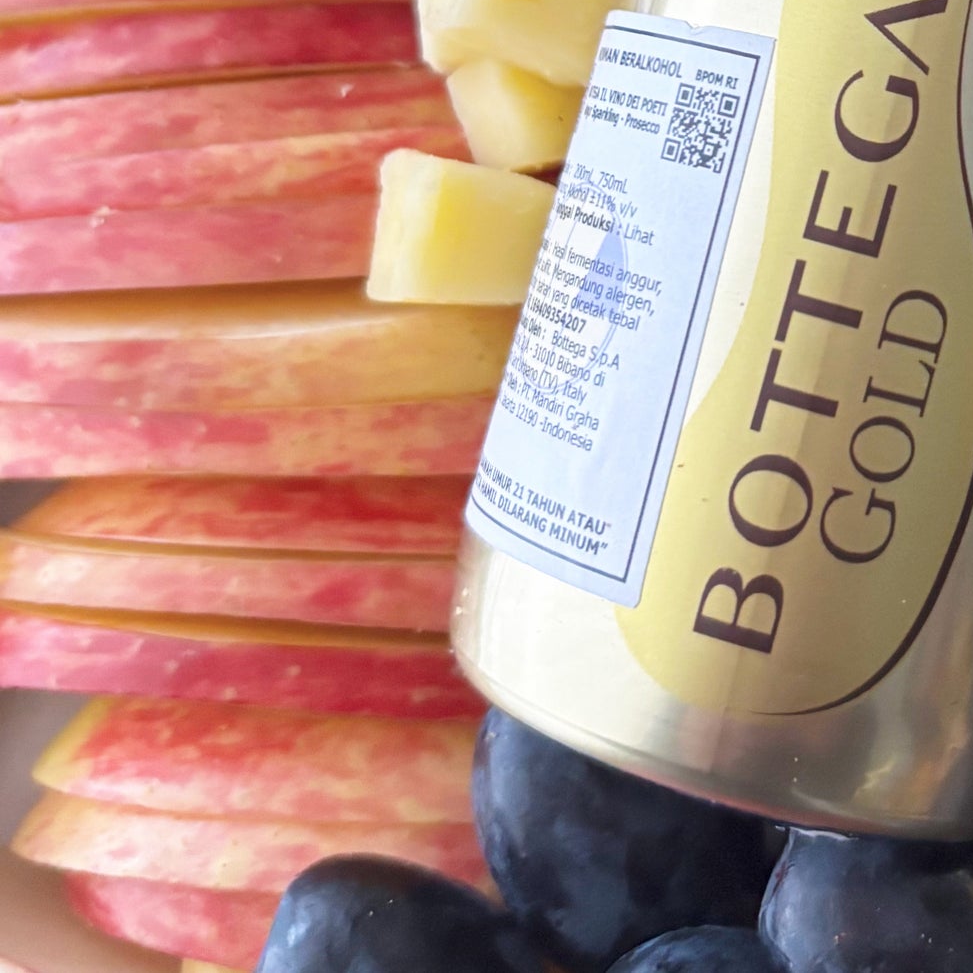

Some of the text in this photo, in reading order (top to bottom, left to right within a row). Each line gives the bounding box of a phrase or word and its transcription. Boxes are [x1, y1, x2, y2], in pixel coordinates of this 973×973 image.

[620, 50, 683, 78] BERALKOHOL
[695, 69, 740, 89] BPOM RI
[591, 105, 620, 127] Sparkling
[624, 113, 661, 135] Prosecco
[600, 87, 608, 102] IL
[609, 89, 627, 106] VINO
[626, 93, 641, 110] DEI
[641, 97, 668, 116] POETI
[598, 171, 629, 194] 750mL
[574, 206, 617, 233] Produksi
[624, 223, 655, 246] Lihat
[619, 201, 638, 218] v/v
[553, 262, 604, 300] Mengandung
[605, 284, 655, 317] alergen,
[567, 247, 615, 277] fermentasi
[616, 268, 662, 297] anggur,
[551, 288, 570, 310] yang
[571, 293, 606, 320] dicetak
[608, 308, 640, 331] tebal
[551, 330, 587, 359] Bottega
[532, 343, 557, 368] 31010
[556, 356, 591, 382] Bibano
[593, 371, 607, 387] di
[532, 389, 565, 416] Mandiri
[565, 404, 600, 431] Graha
[562, 380, 588, 406] Italy
[818, 289, 949, 565] GOLD
[492, 467, 512, 493] UMUR
[513, 482, 525, 500] 21
[526, 489, 567, 520] TAHUN
[497, 496, 548, 533] DILARANG
